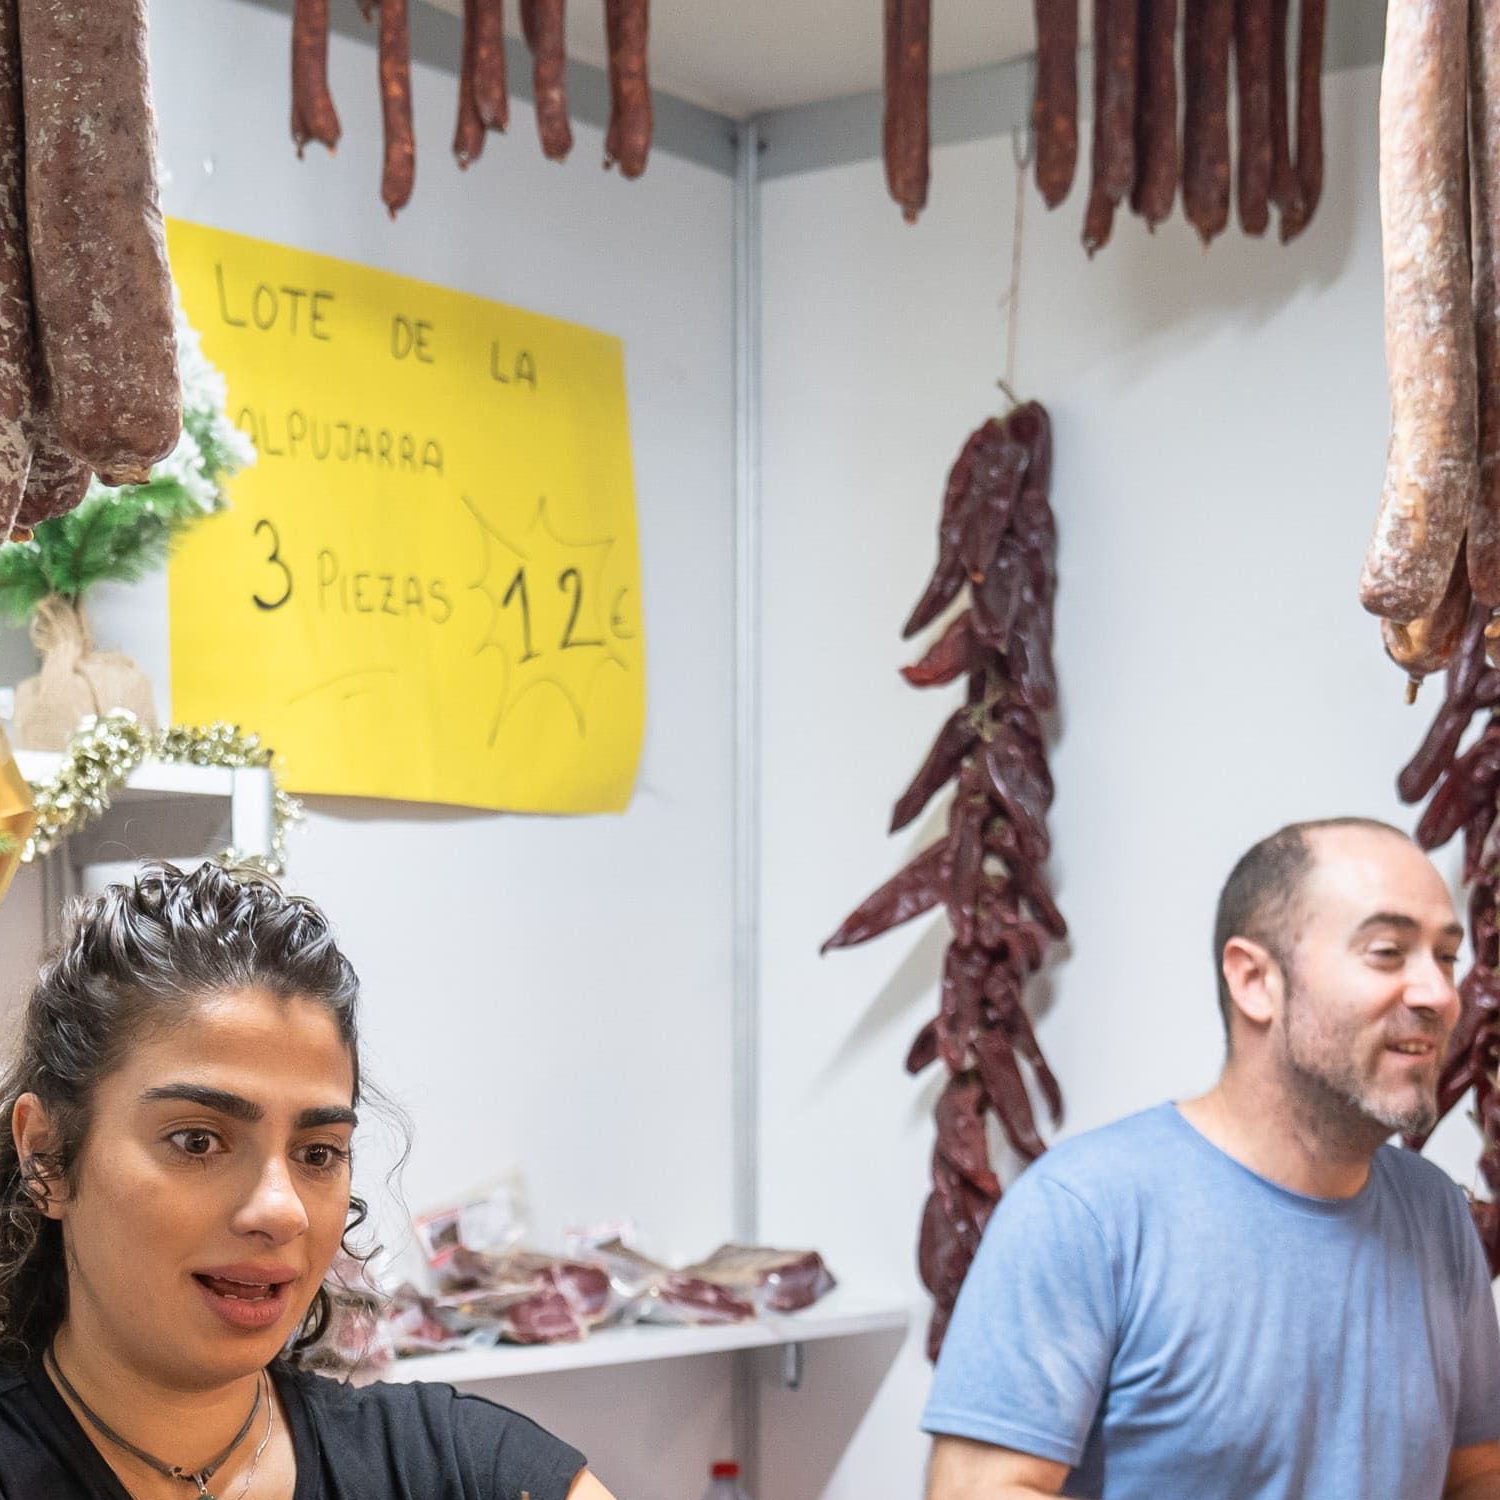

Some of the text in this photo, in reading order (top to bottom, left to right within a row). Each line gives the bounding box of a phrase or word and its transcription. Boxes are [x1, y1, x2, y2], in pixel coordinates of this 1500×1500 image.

[214, 263, 537, 391] LOTE DE LA
[252, 519, 293, 611] 3
[317, 549, 453, 624] PIEZAS
